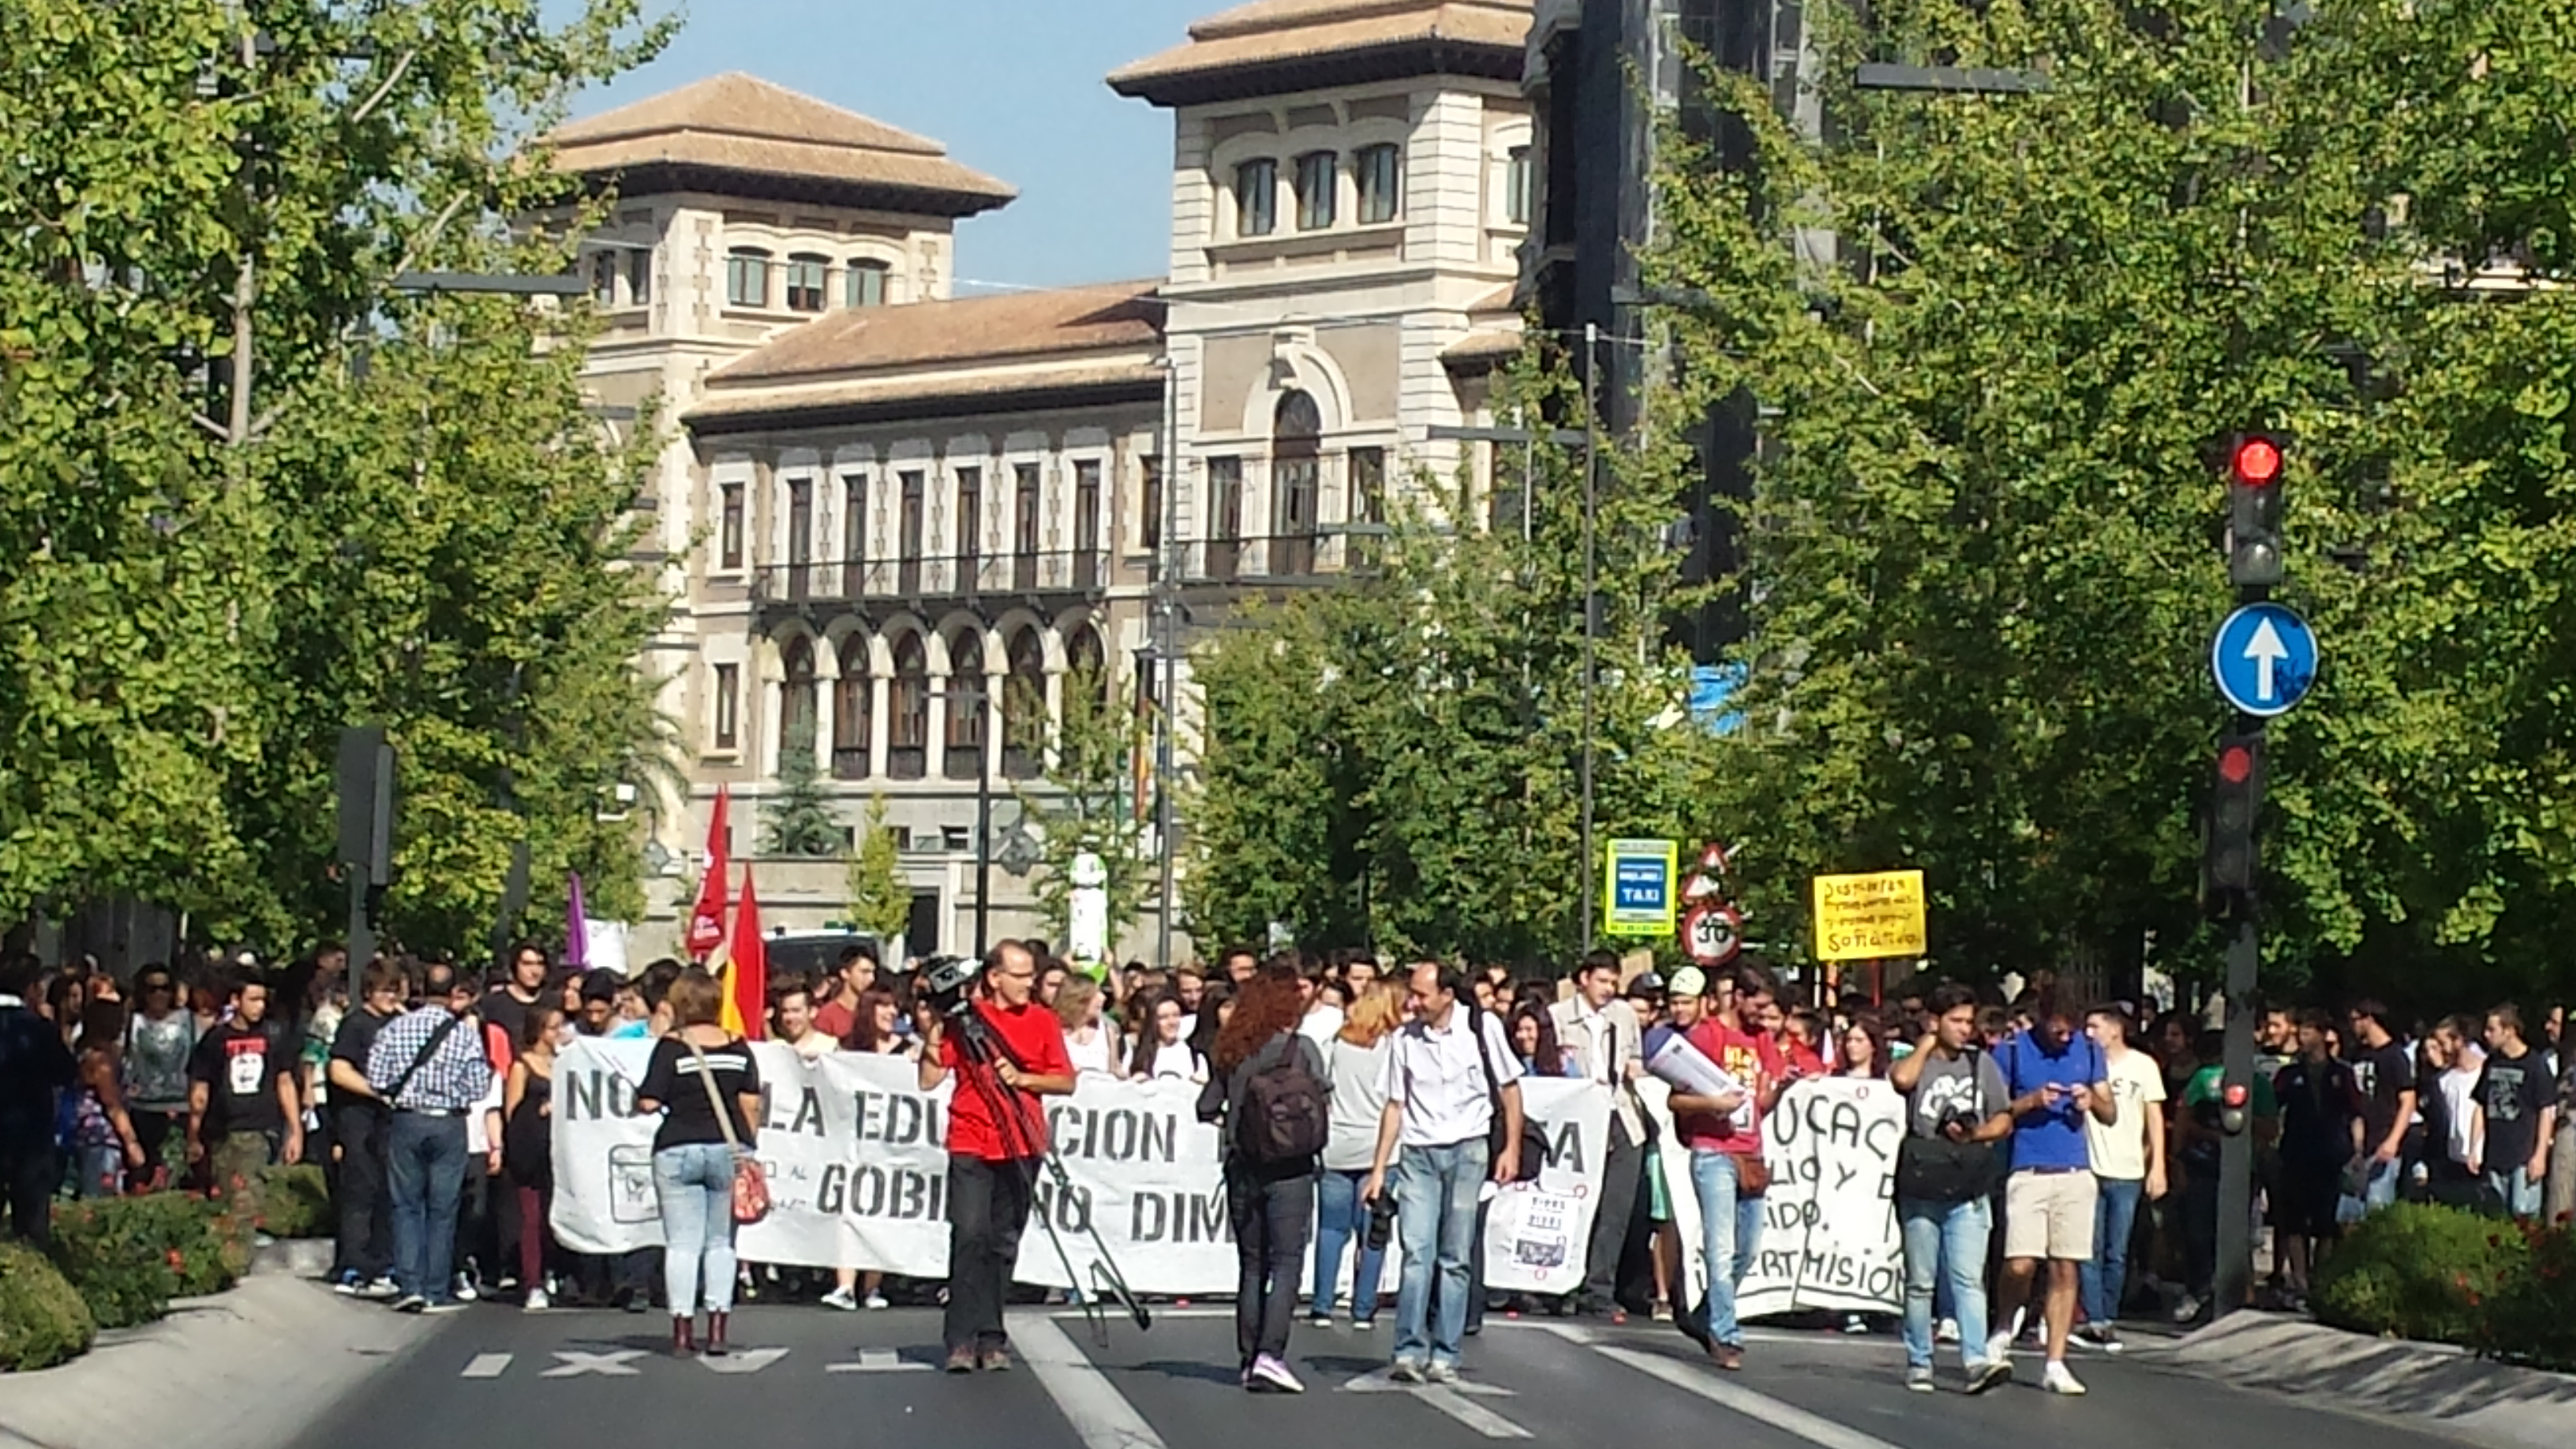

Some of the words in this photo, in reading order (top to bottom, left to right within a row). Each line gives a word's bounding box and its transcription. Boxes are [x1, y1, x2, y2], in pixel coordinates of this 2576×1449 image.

[1621, 888, 1660, 902] TAXI
[1697, 918, 1728, 943] 30
[566, 1069, 637, 1121] NO
[758, 1081, 826, 1137] LA
[1773, 1095, 1898, 1161] UCAC
[1834, 1161, 1857, 1191] Y
[1131, 1192, 1237, 1244] DIM
